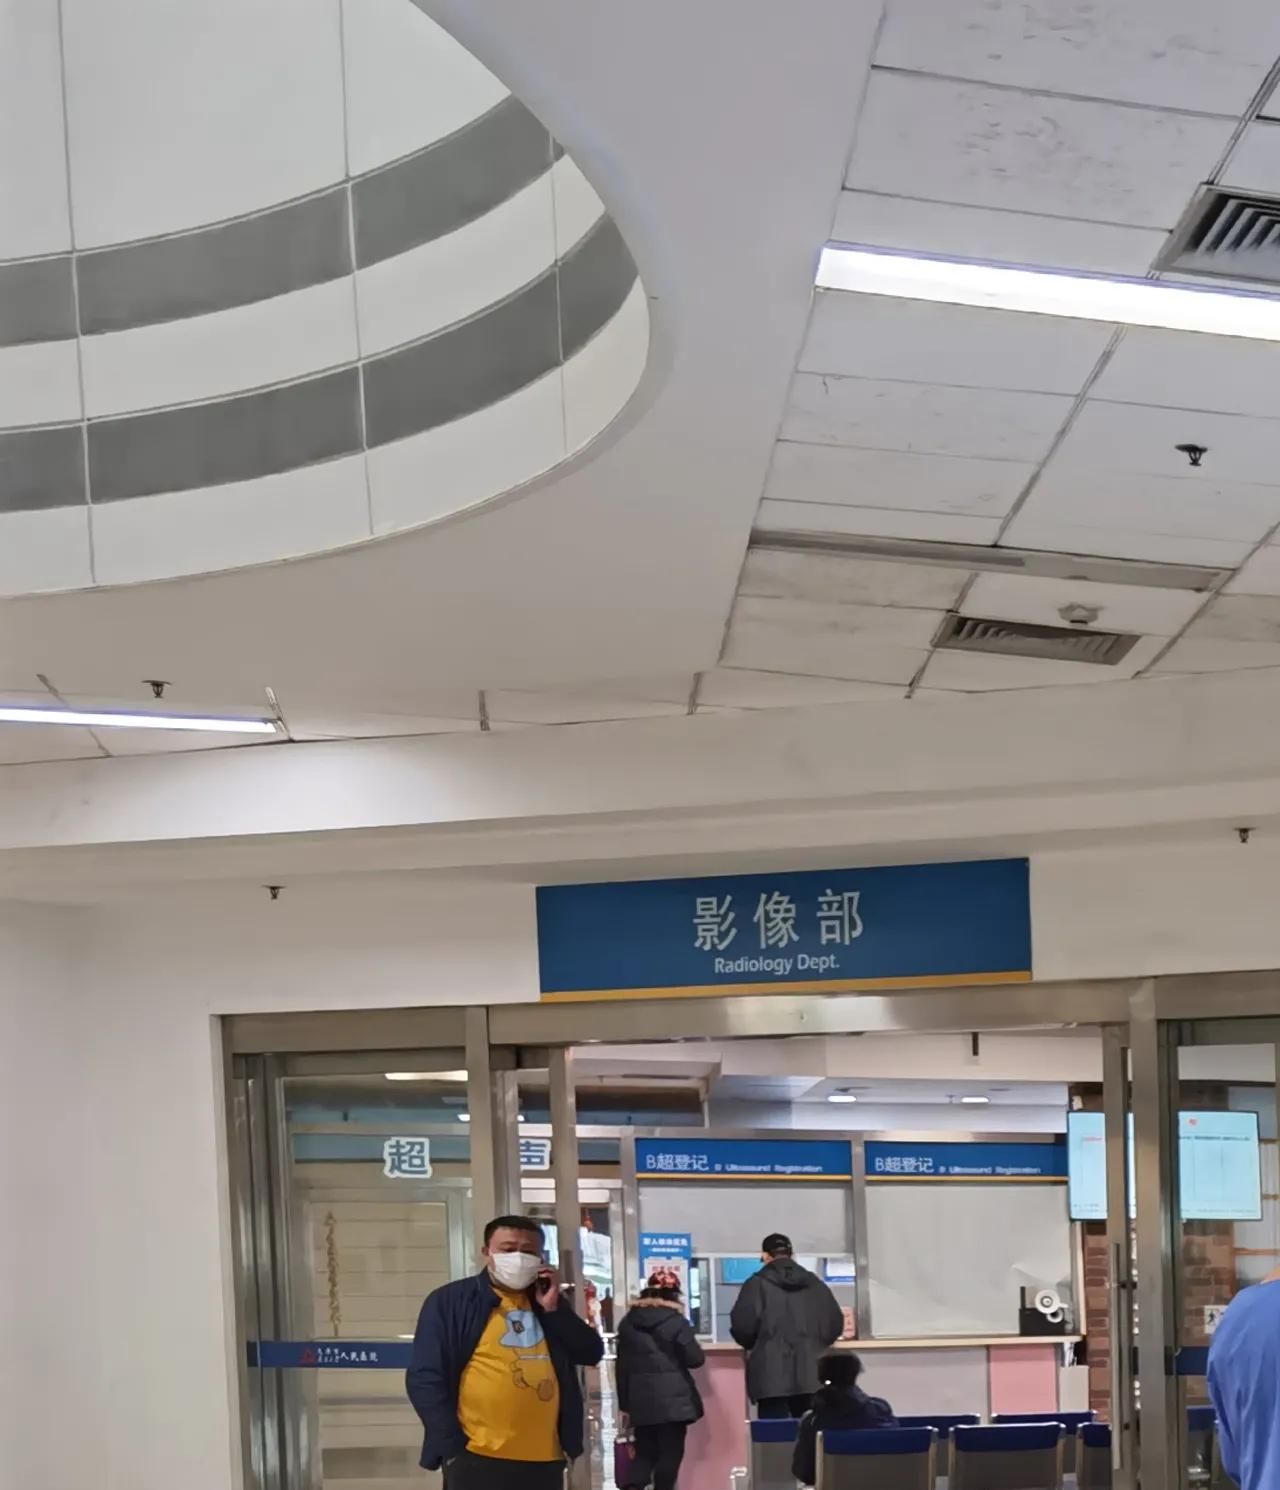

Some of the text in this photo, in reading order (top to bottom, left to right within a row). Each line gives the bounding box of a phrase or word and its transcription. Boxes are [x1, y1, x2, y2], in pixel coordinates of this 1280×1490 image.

[693, 888, 864, 952] 影像部
[714, 952, 840, 976] Radiology Dept.
[386, 1139, 431, 1177] 超
[646, 1153, 710, 1171] B超登记
[875, 1156, 934, 1174] B超登记
